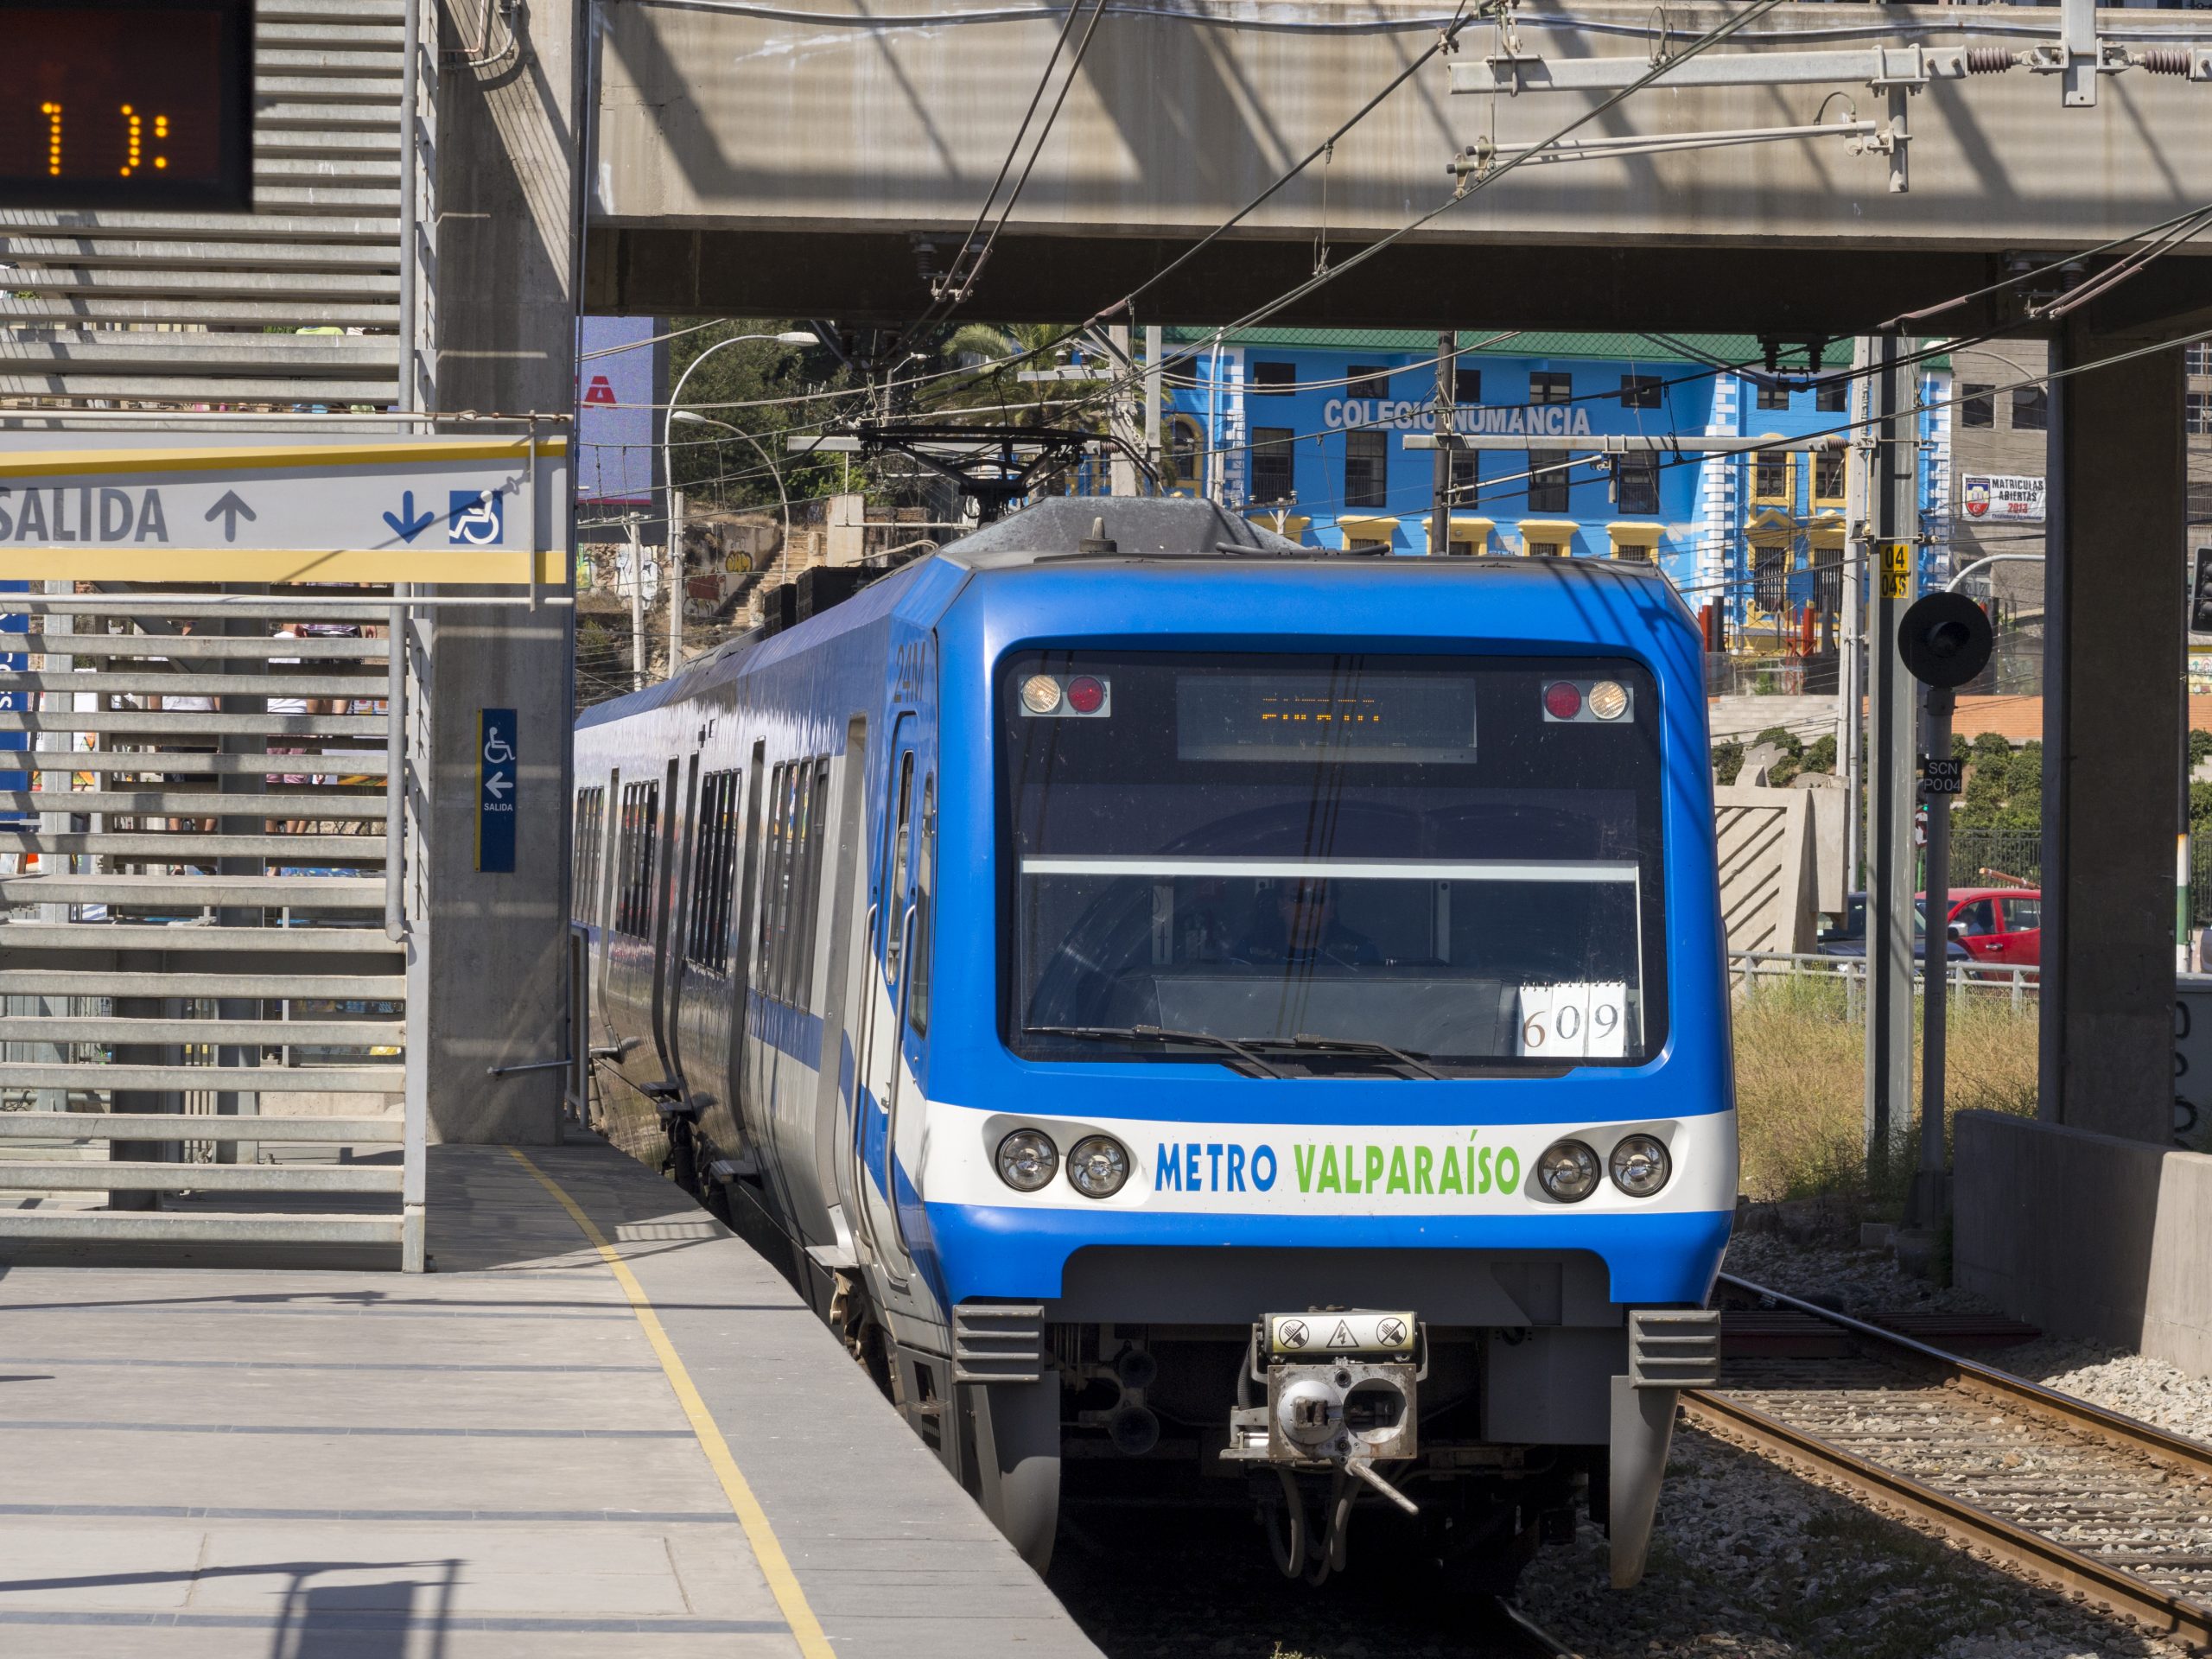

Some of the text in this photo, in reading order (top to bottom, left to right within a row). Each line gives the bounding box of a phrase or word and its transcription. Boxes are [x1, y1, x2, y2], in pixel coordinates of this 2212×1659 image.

[1324, 398, 1592, 435] COLEGIO NUMANCIA
[1992, 479, 2044, 492] MATRICULAS
[1999, 490, 2037, 502] ABIERTAS
[0, 486, 169, 543] SALIDA
[1885, 545, 1905, 569] 04
[1881, 574, 1907, 597] 04S
[1928, 761, 1958, 775] SCN
[484, 803, 513, 811] SALIDA
[1522, 1004, 1618, 1048] 609
[1154, 1129, 1521, 1196] METRO VALPARAÍSO
